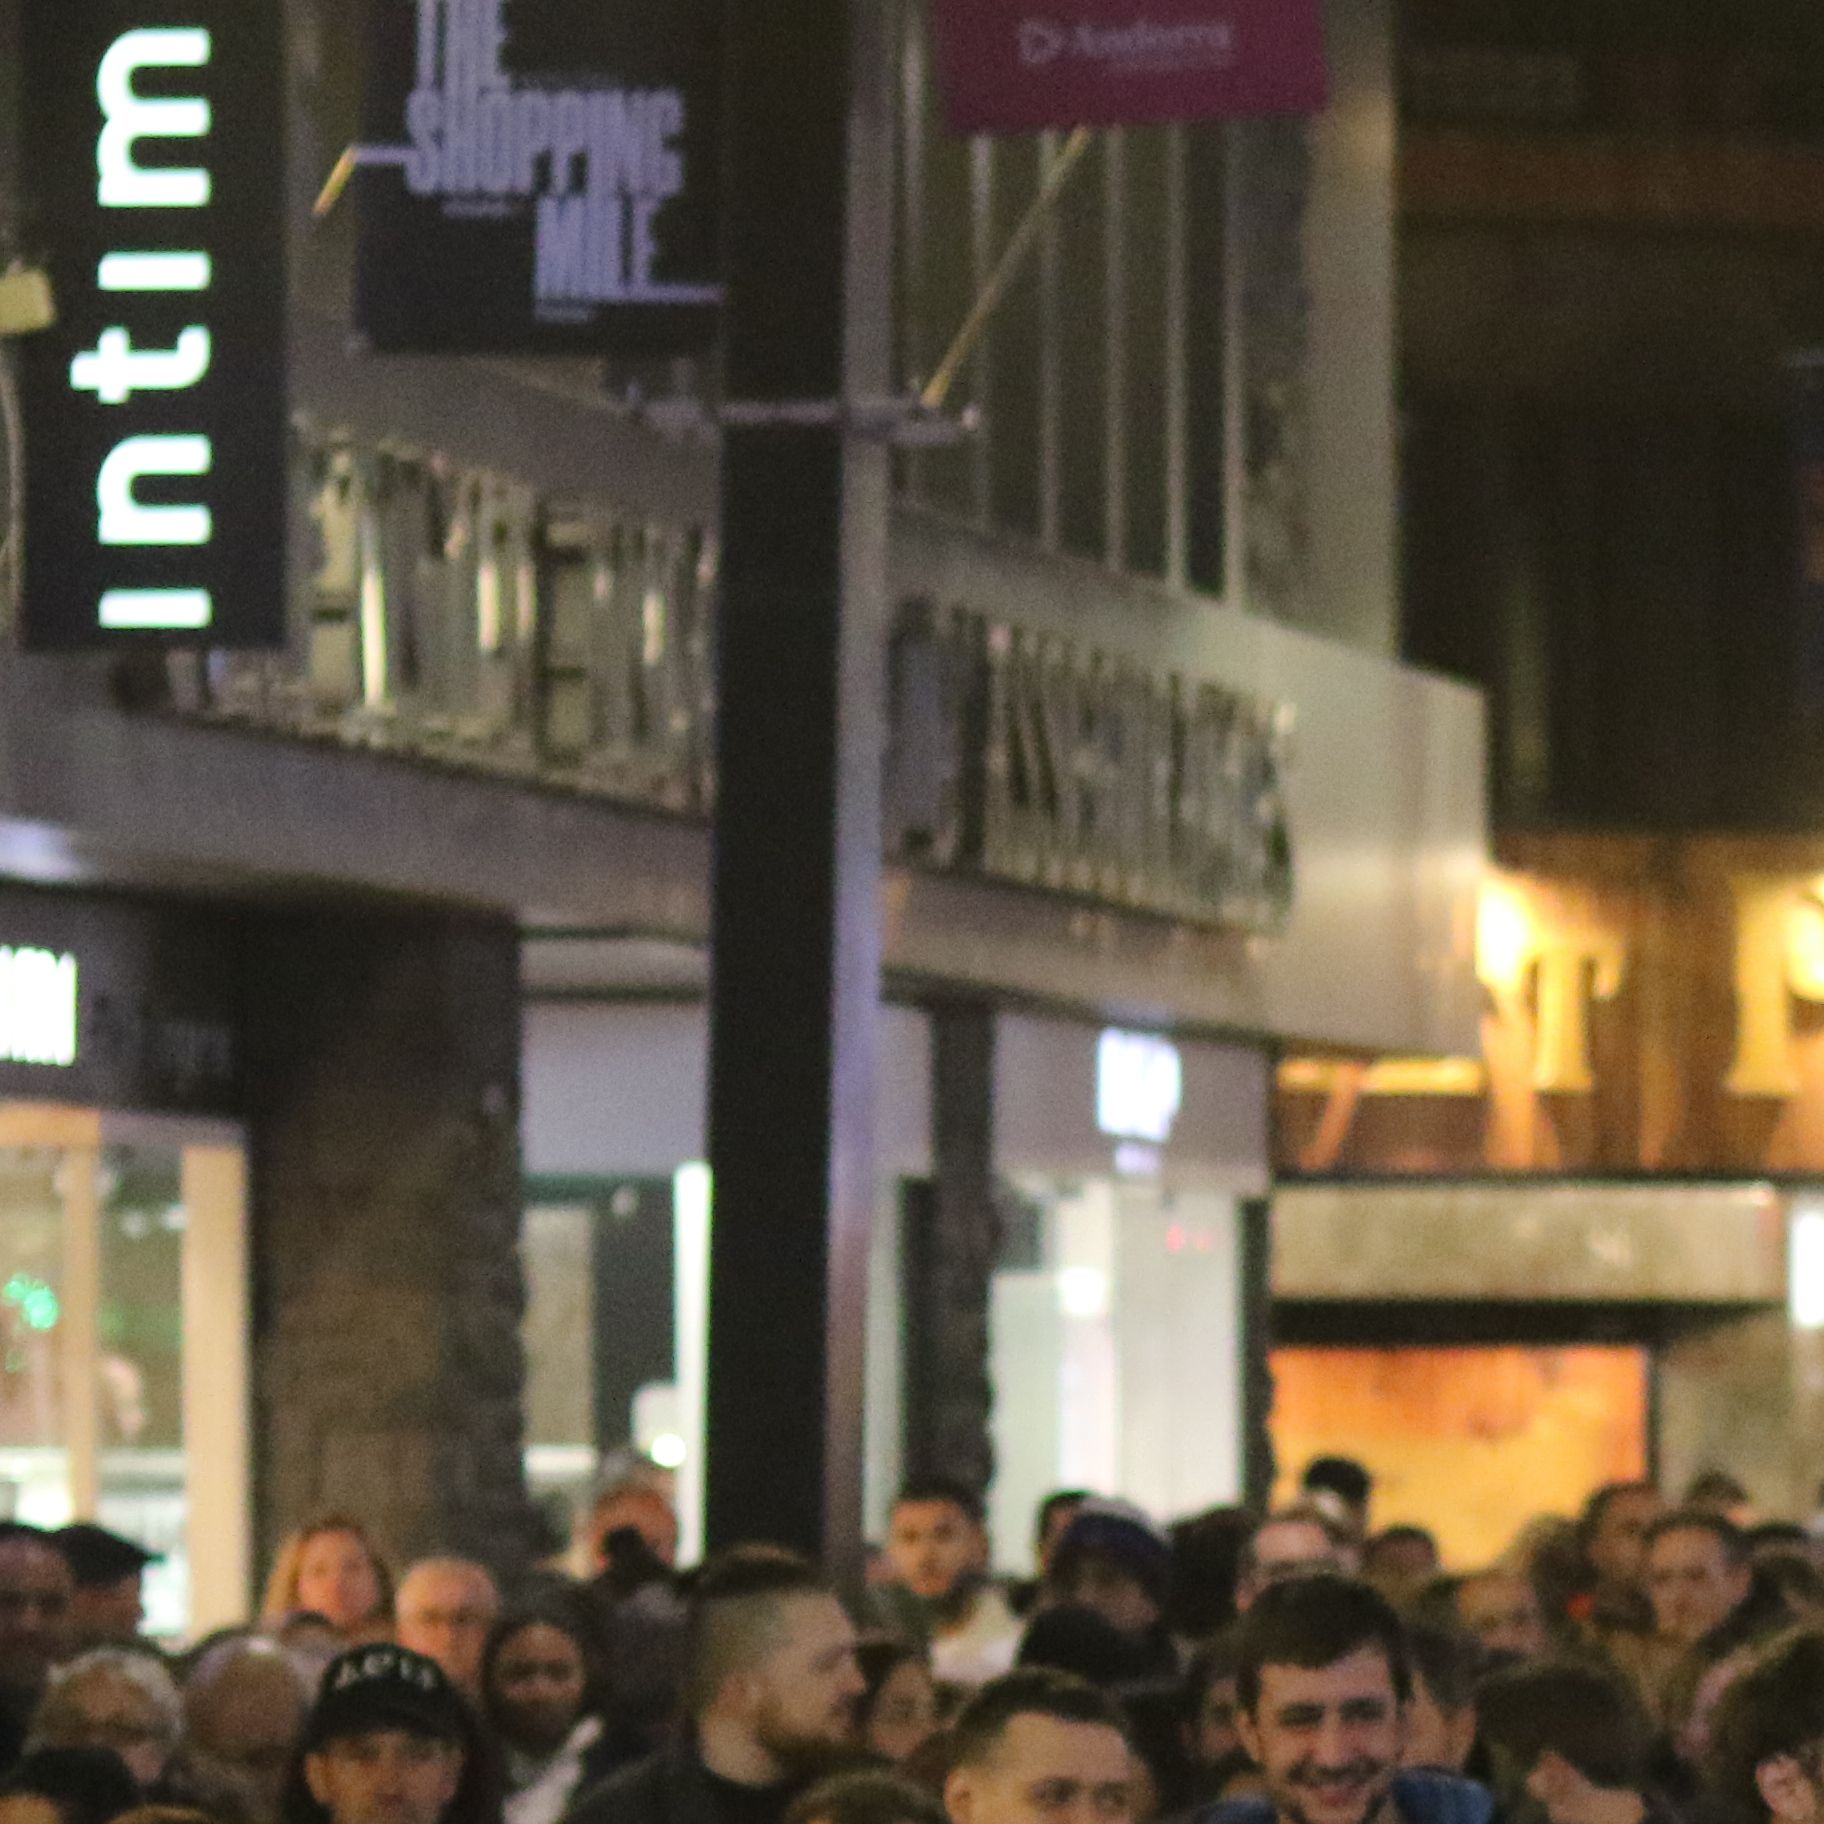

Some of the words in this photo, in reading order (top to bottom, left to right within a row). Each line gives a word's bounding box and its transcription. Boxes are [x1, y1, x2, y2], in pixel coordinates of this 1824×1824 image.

[405, 88, 684, 196] SHOPPING
[535, 197, 700, 304] MILE
[71, 28, 211, 629] intim
